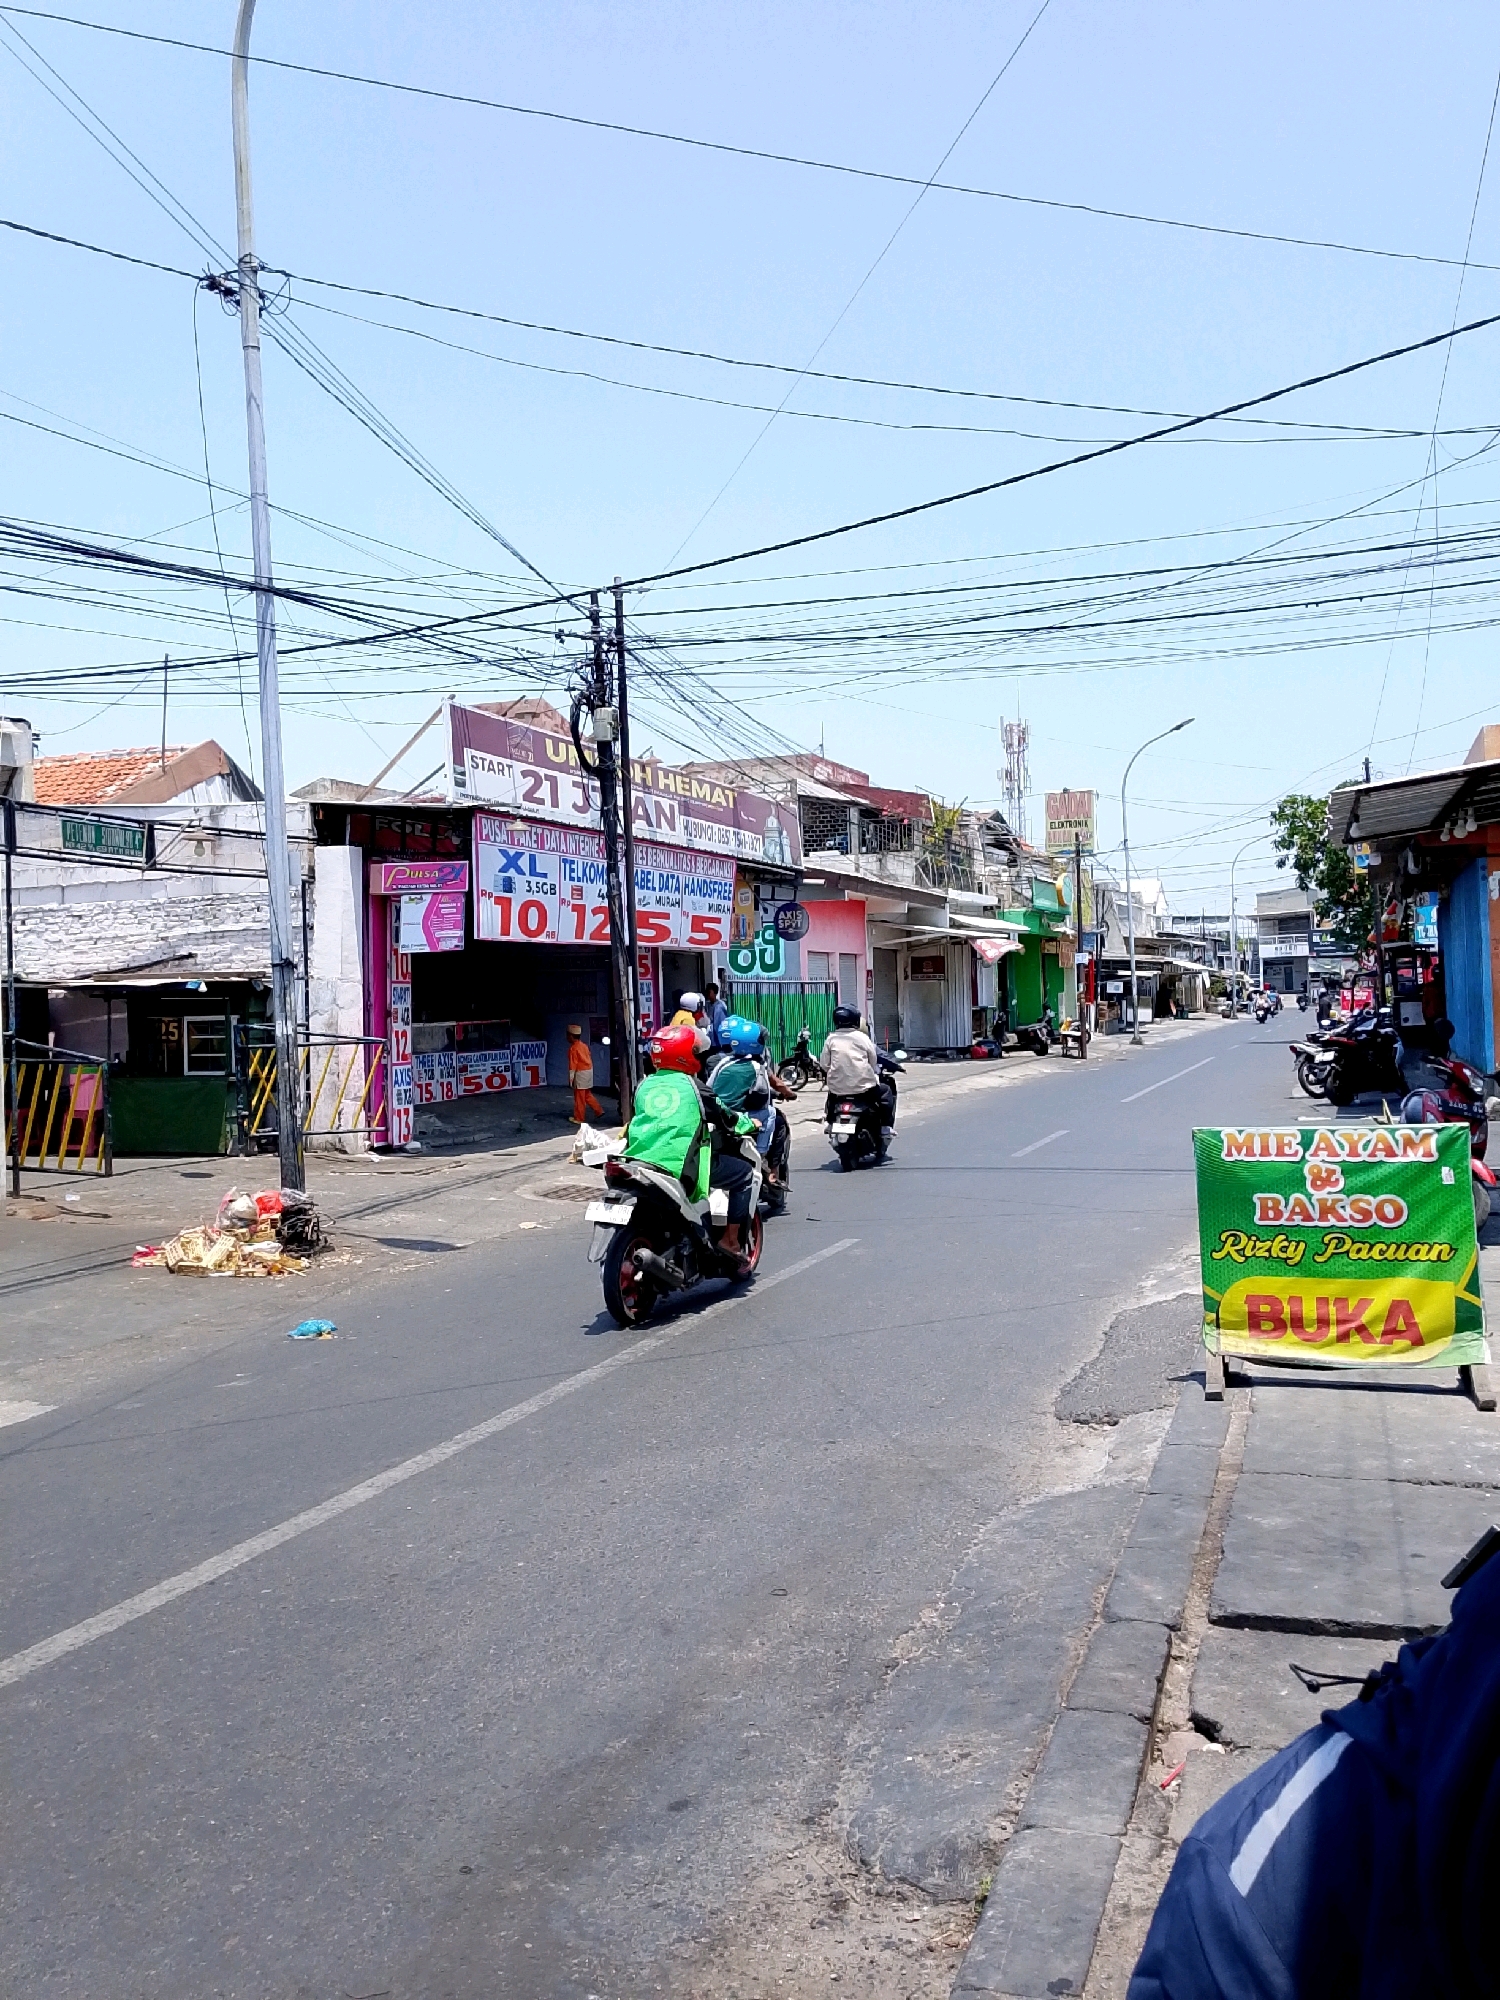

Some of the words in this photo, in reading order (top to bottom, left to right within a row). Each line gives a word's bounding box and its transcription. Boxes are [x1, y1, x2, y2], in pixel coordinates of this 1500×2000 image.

[470, 754, 513, 778] START
[520, 769, 560, 809] 21
[657, 770, 736, 809] HEMAT
[1047, 791, 1092, 820] GADAI
[481, 818, 511, 842] PUSAT
[544, 829, 567, 853] DATA
[648, 848, 691, 872] BERKUALITAS
[697, 862, 733, 879] BERGARANSI
[498, 849, 548, 879] XL
[480, 889, 493, 900] Rp
[526, 880, 557, 896] 3,5GB
[634, 868, 656, 892] ABEL
[658, 873, 680, 895] DATA
[684, 876, 732, 901] HANDSFREE
[655, 896, 680, 908] MURAH
[708, 903, 730, 915] MURAH
[779, 911, 802, 919] AXIS
[494, 896, 548, 938] 10
[571, 904, 611, 941] 12
[637, 910, 671, 943] 5
[687, 915, 722, 946] 5
[394, 1029, 408, 1061] 12
[517, 1043, 545, 1059] ANDROID
[415, 1055, 434, 1069] THREE
[438, 1053, 453, 1067] AXIS
[490, 1065, 510, 1074] 3GB
[394, 1068, 411, 1087] AXIS
[440, 1081, 453, 1100] 18
[463, 1074, 508, 1093] 50
[416, 1083, 433, 1102] 15
[396, 1108, 410, 1143] 13
[1222, 1130, 1302, 1160] MIE
[1307, 1130, 1437, 1160] AYAM
[1305, 1162, 1343, 1193] &
[1254, 1194, 1407, 1227] BAKSO
[1212, 1231, 1306, 1264] Rizky
[1315, 1233, 1455, 1263] Pacuan
[1244, 1294, 1425, 1346] BUKA
